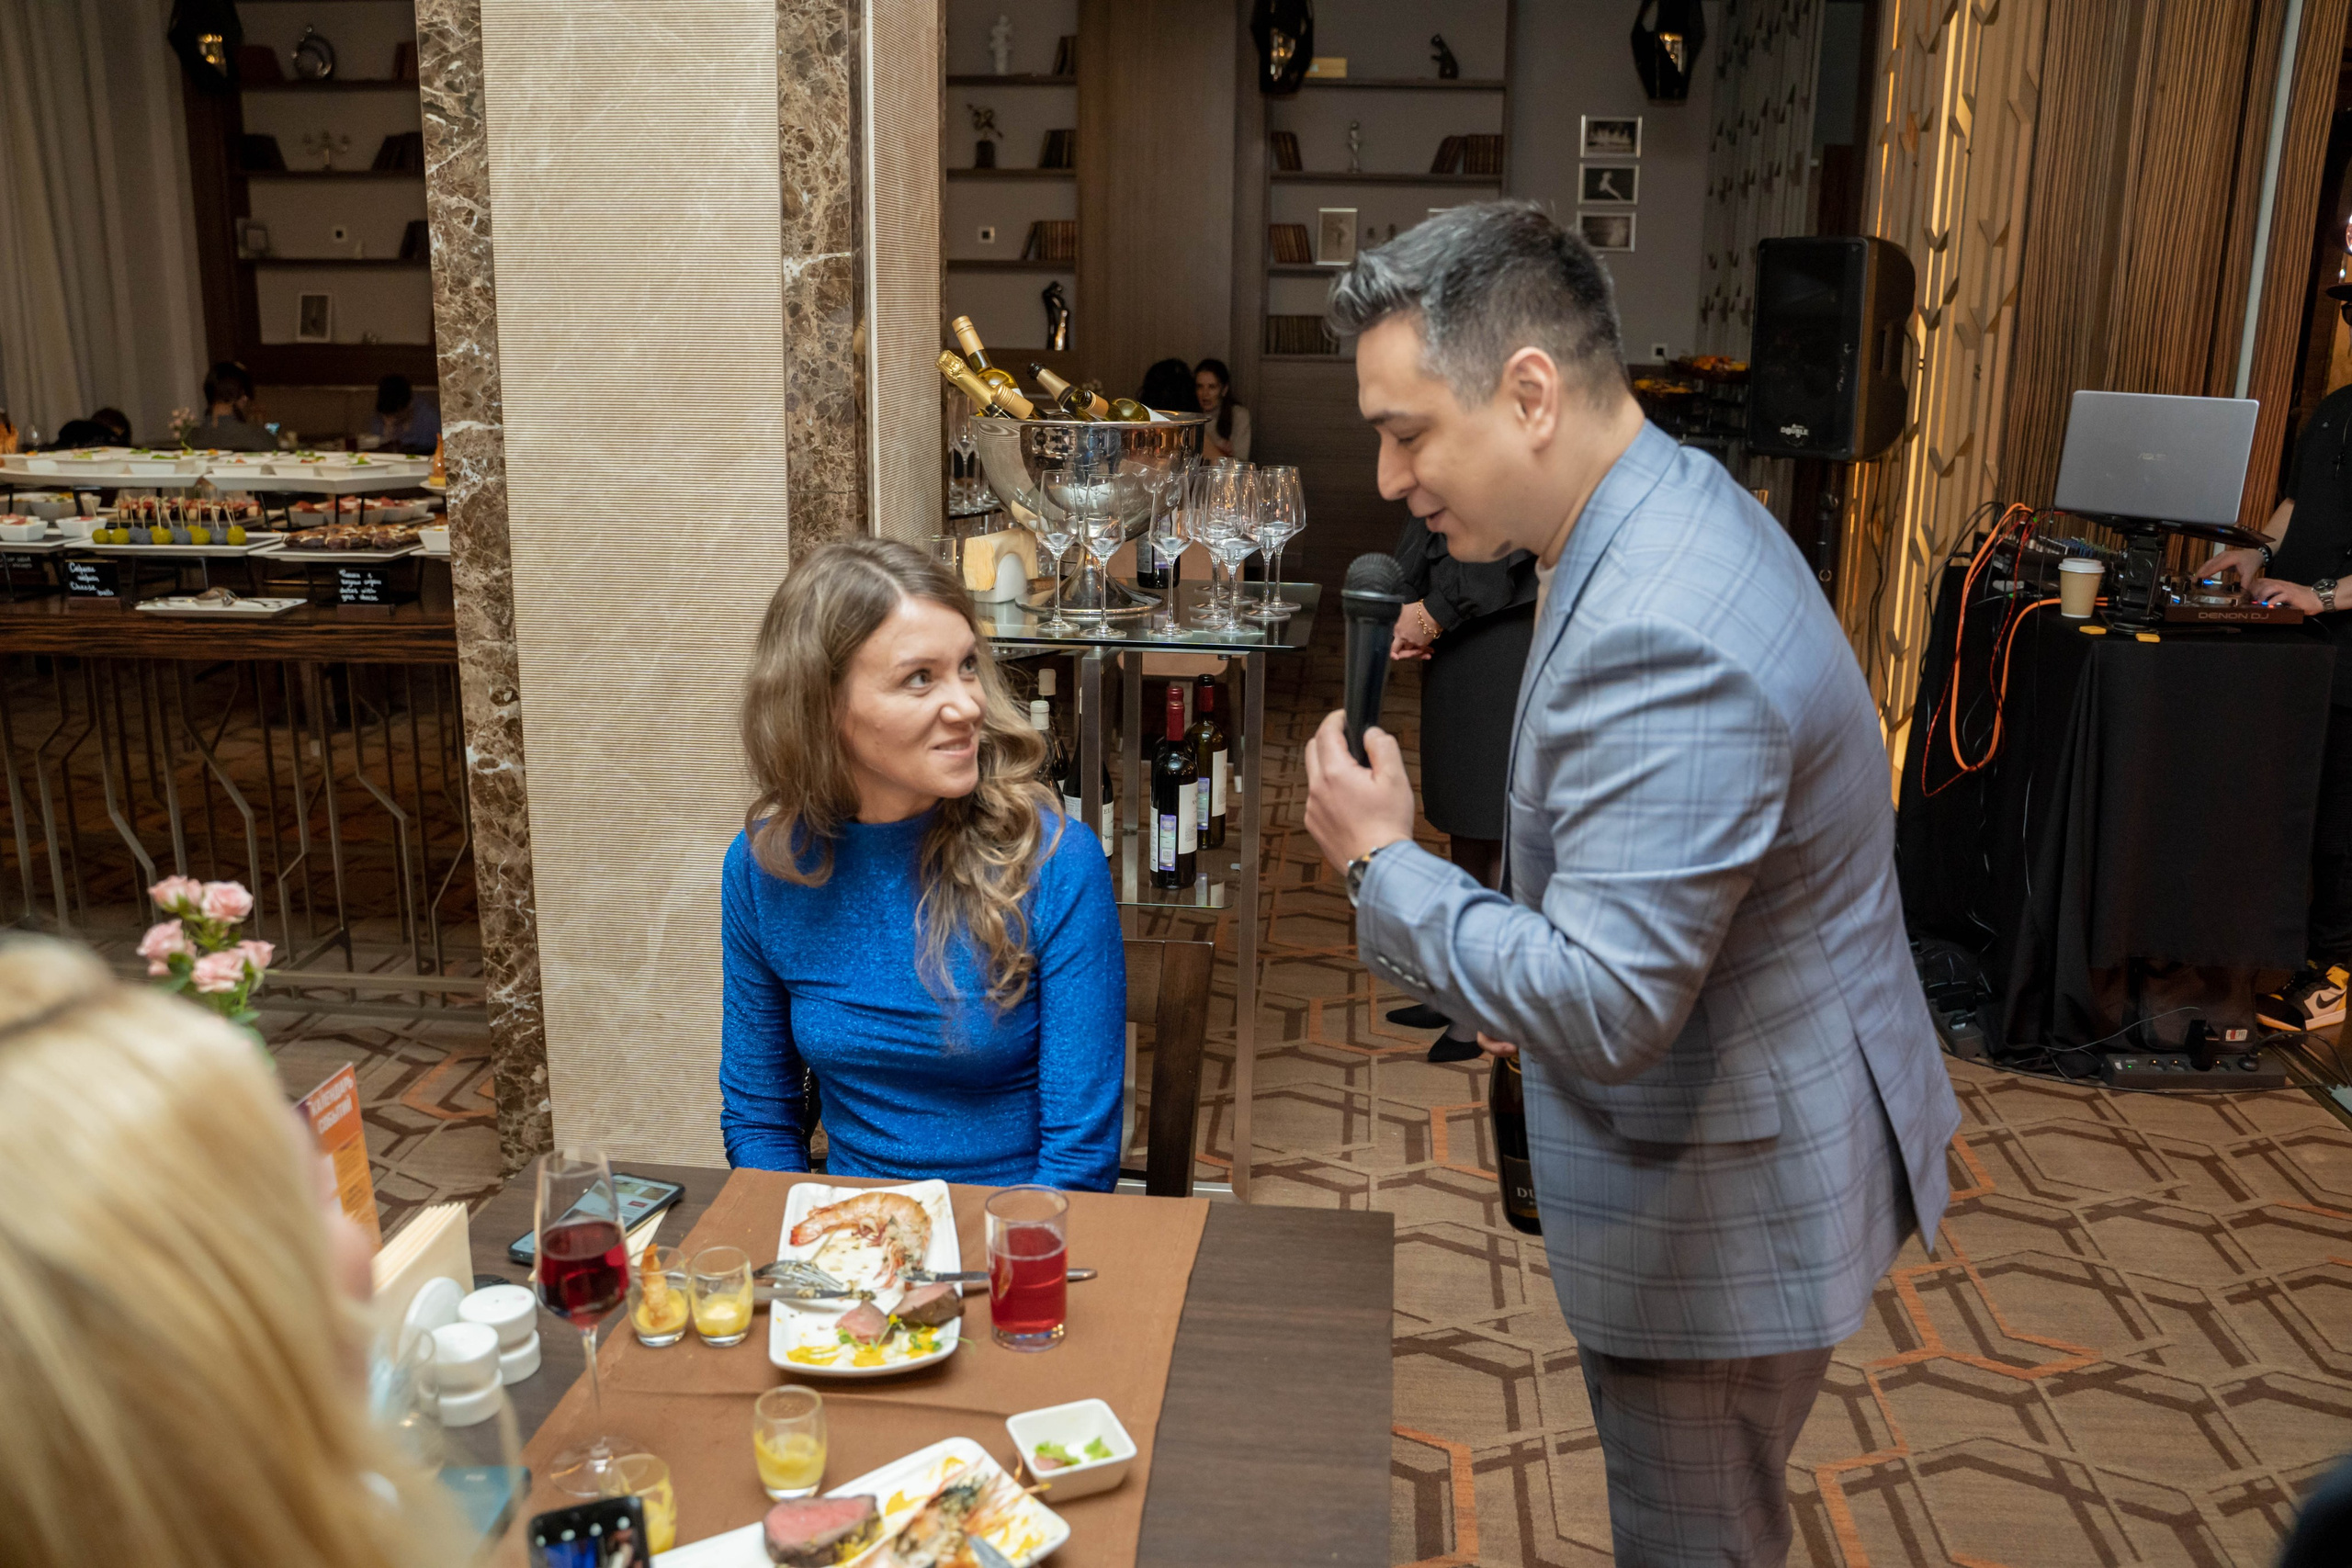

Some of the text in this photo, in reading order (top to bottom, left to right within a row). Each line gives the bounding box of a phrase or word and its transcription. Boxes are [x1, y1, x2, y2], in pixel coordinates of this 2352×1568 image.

[69, 581, 96, 592] Cheese
[96, 588, 115, 596] balls
[2198, 612, 2270, 620] DENON DJ
